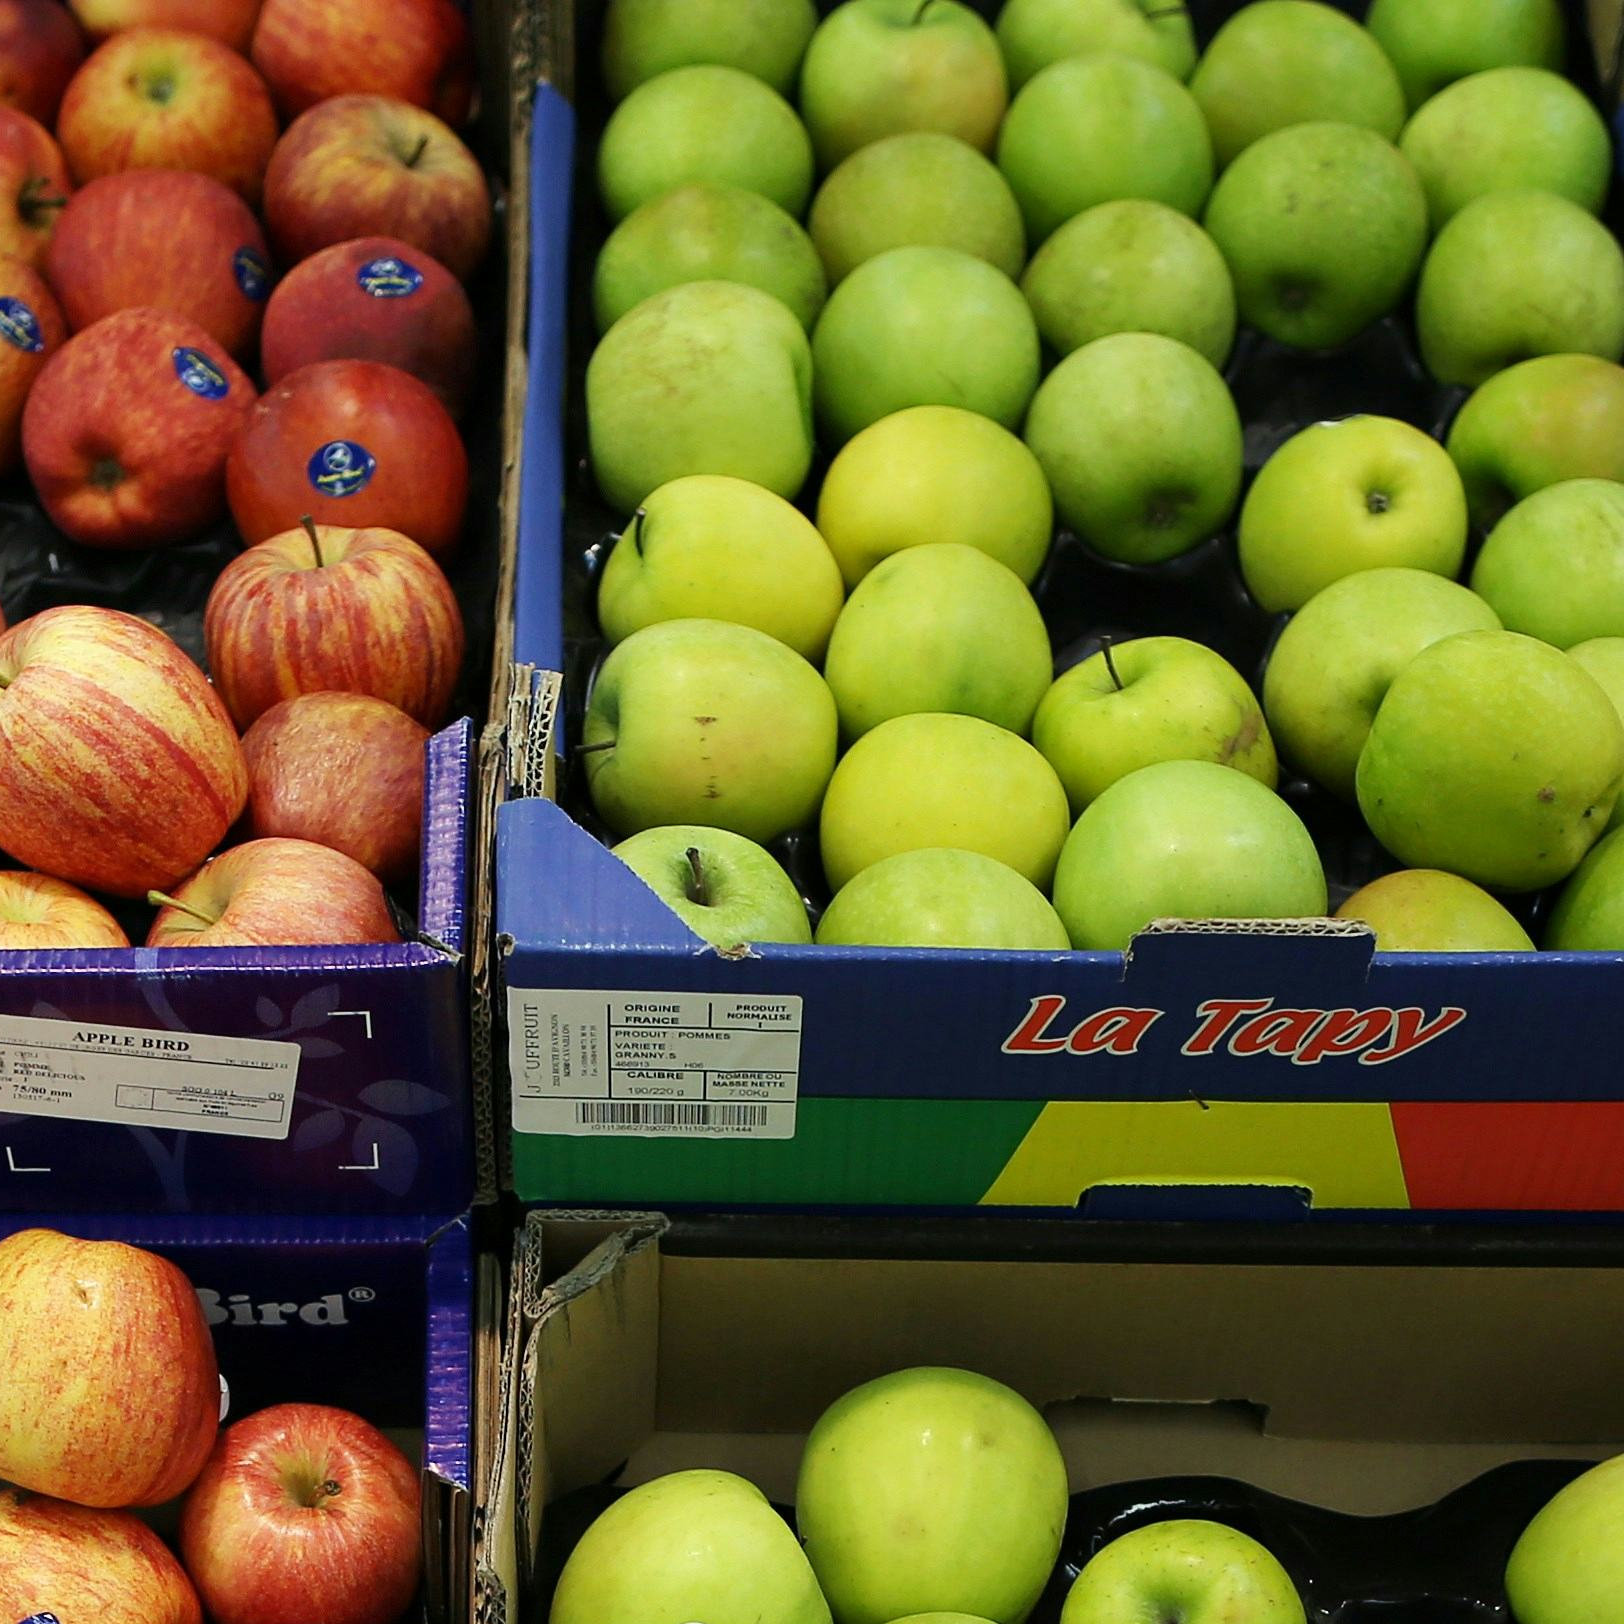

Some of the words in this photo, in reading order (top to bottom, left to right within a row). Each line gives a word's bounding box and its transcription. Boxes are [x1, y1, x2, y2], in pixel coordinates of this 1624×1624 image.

[625, 1004, 680, 1013] ORIGINE
[736, 1004, 787, 1012] PRODUIT
[625, 1016, 680, 1025] FRANCE
[727, 1013, 792, 1021] NORMALISE
[1000, 994, 1166, 1056] La
[1181, 996, 1467, 1066] Tapy
[615, 1031, 669, 1039] PRODUIT
[678, 1032, 731, 1040] POMMES
[73, 1031, 135, 1047] APPLE
[142, 1038, 190, 1051] BIRD
[615, 1042, 666, 1050] VARIETE
[627, 1072, 684, 1080] CALIBRE
[751, 1081, 785, 1089] NETTE
[50, 1089, 73, 1099] mm
